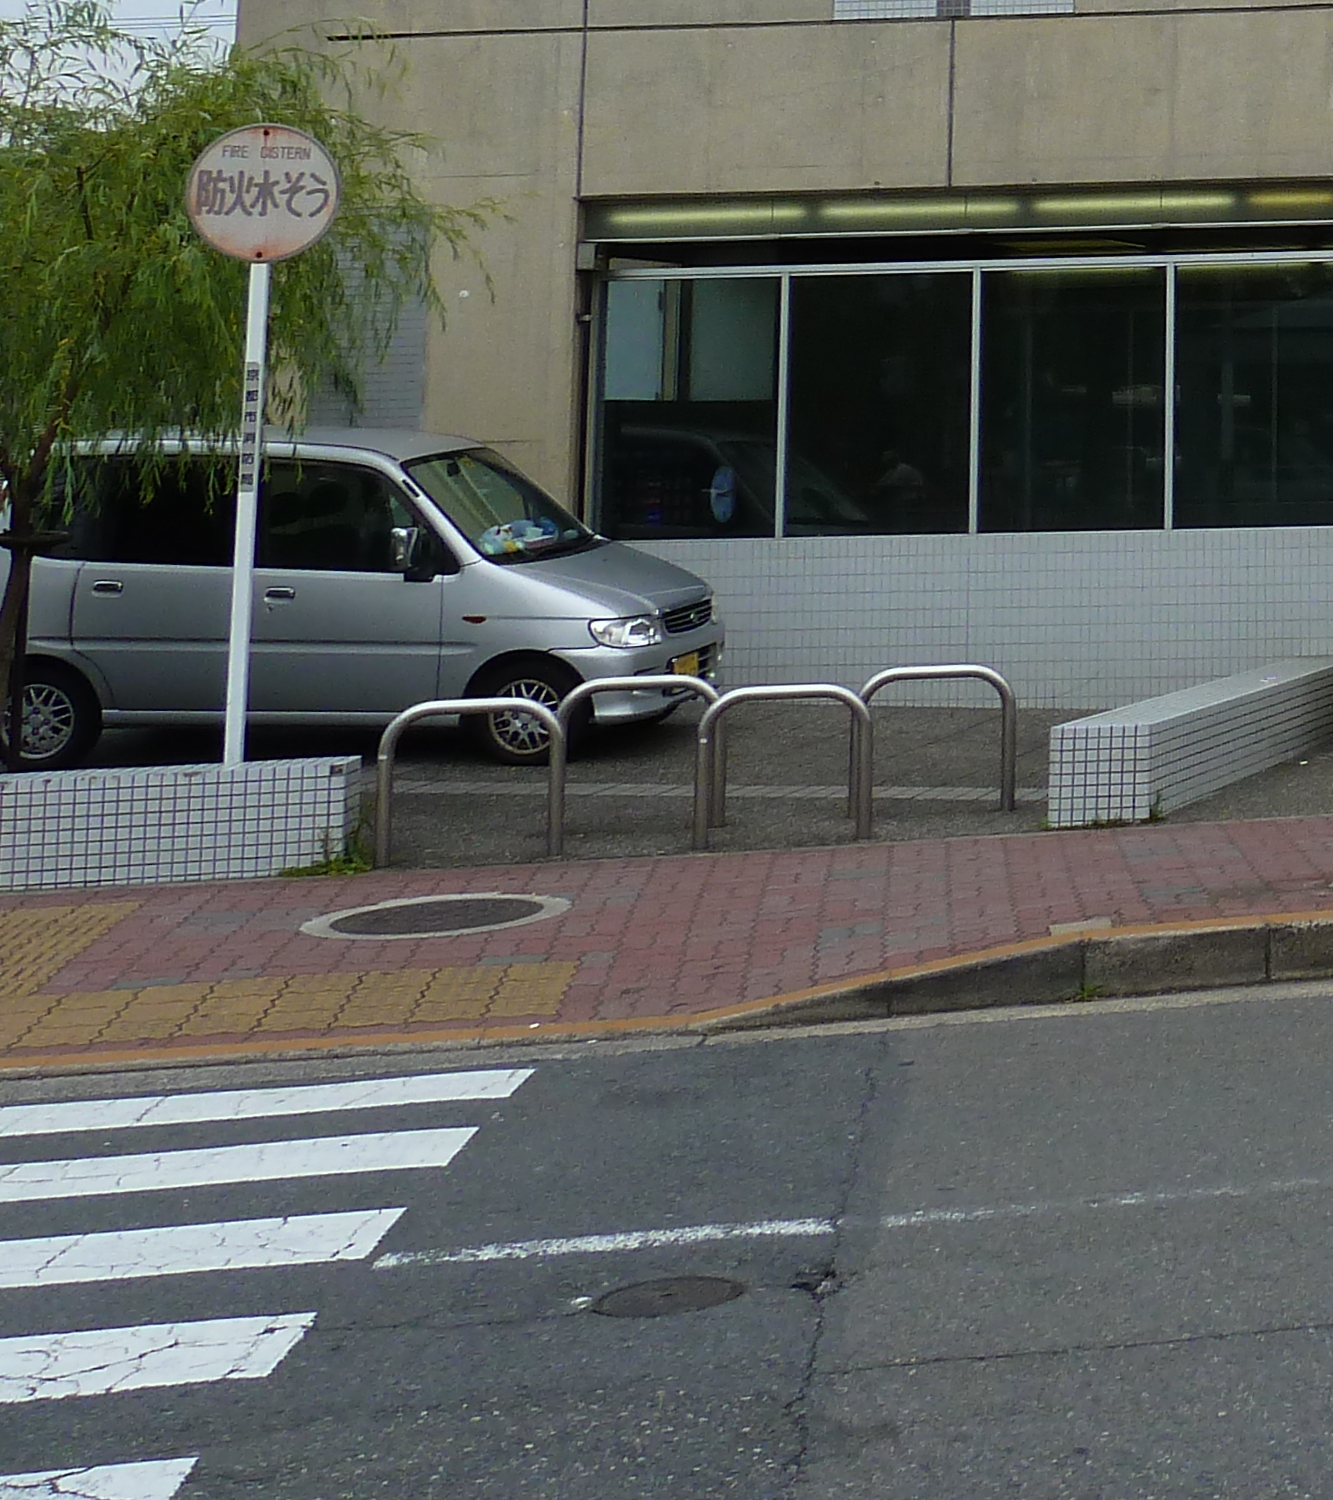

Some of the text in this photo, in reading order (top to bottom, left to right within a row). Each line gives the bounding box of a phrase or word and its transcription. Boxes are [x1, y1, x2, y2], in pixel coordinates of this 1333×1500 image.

[222, 145, 250, 158] FIRE
[196, 169, 331, 217] 防火水そう
